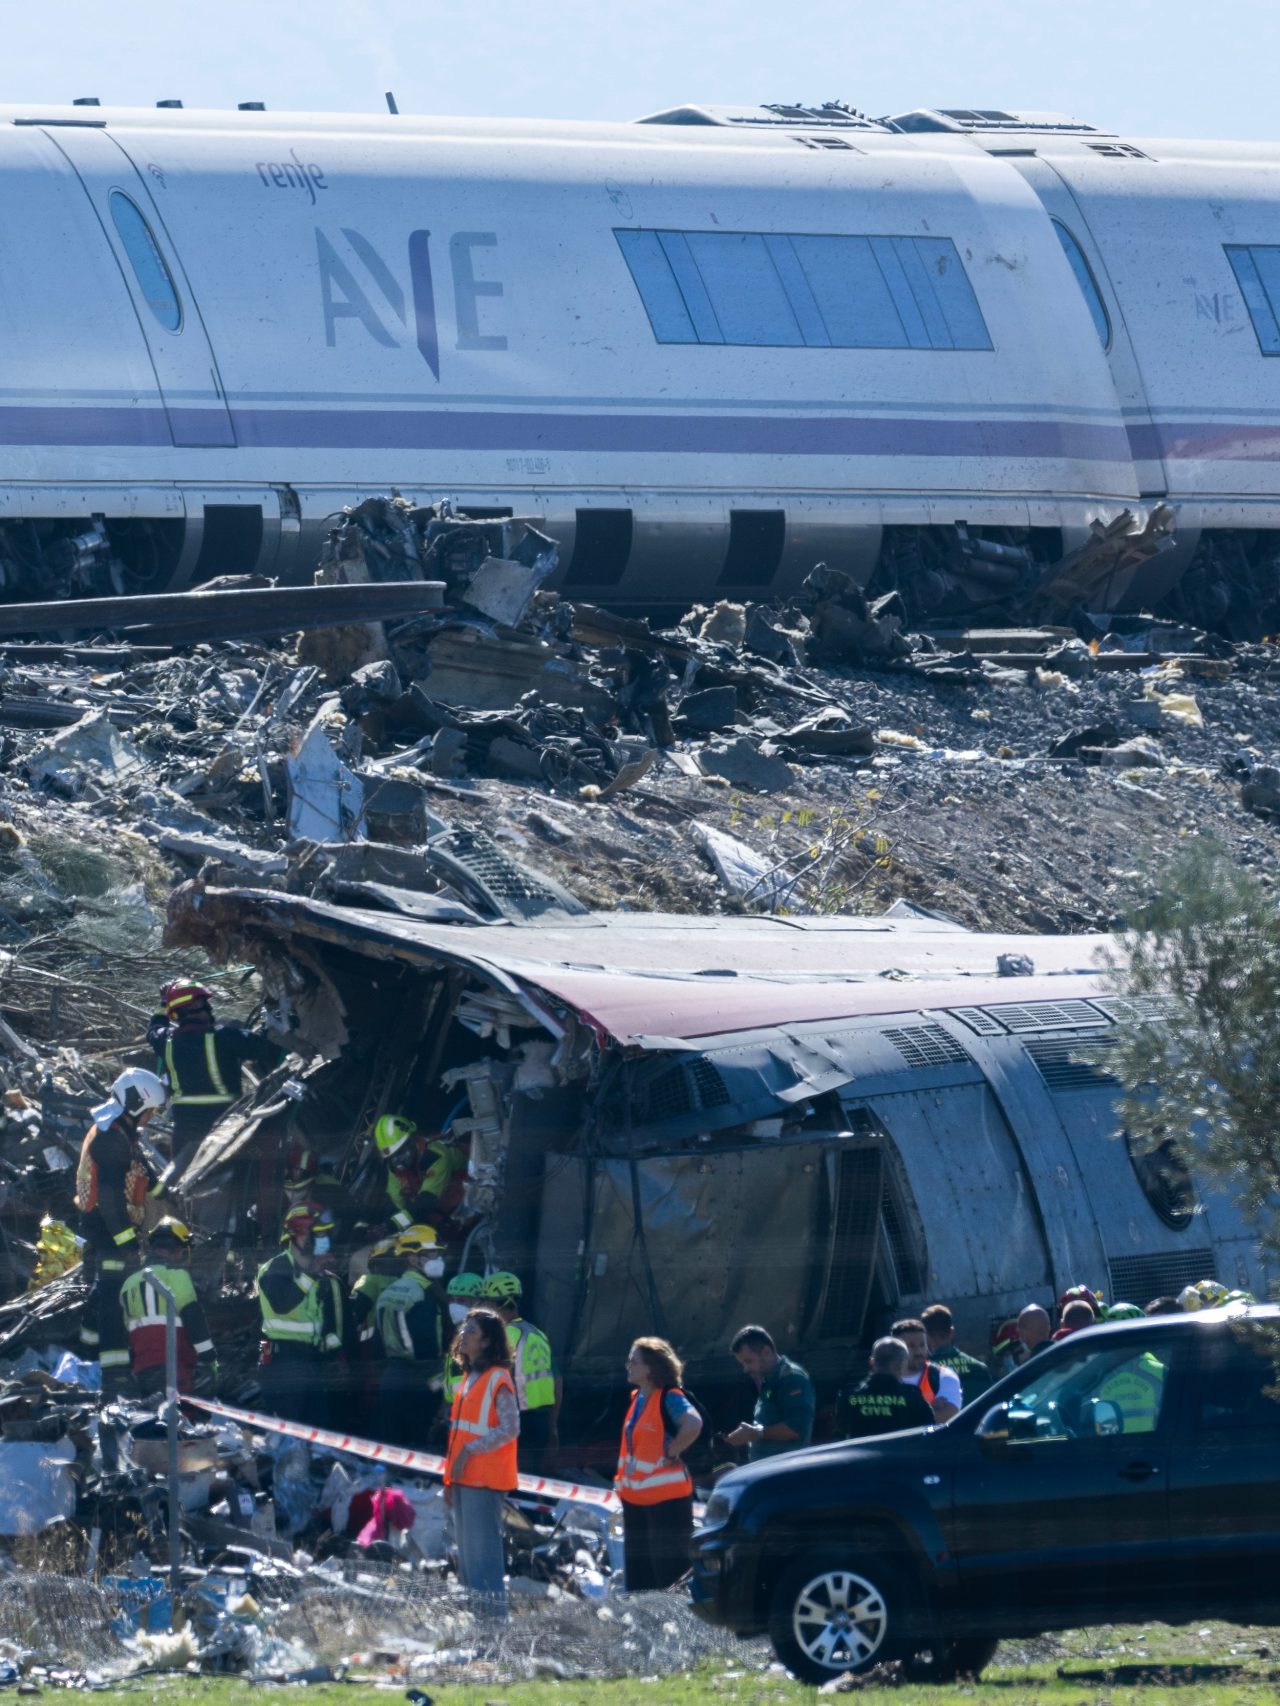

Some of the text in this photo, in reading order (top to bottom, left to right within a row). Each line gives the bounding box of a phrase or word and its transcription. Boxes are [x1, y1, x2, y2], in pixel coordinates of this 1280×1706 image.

[256, 148, 328, 205] renfe
[315, 226, 508, 383] AVE
[1194, 293, 1235, 324] AVE
[849, 1395, 907, 1407] GUARDIA
[861, 1406, 893, 1417] CIVIL
